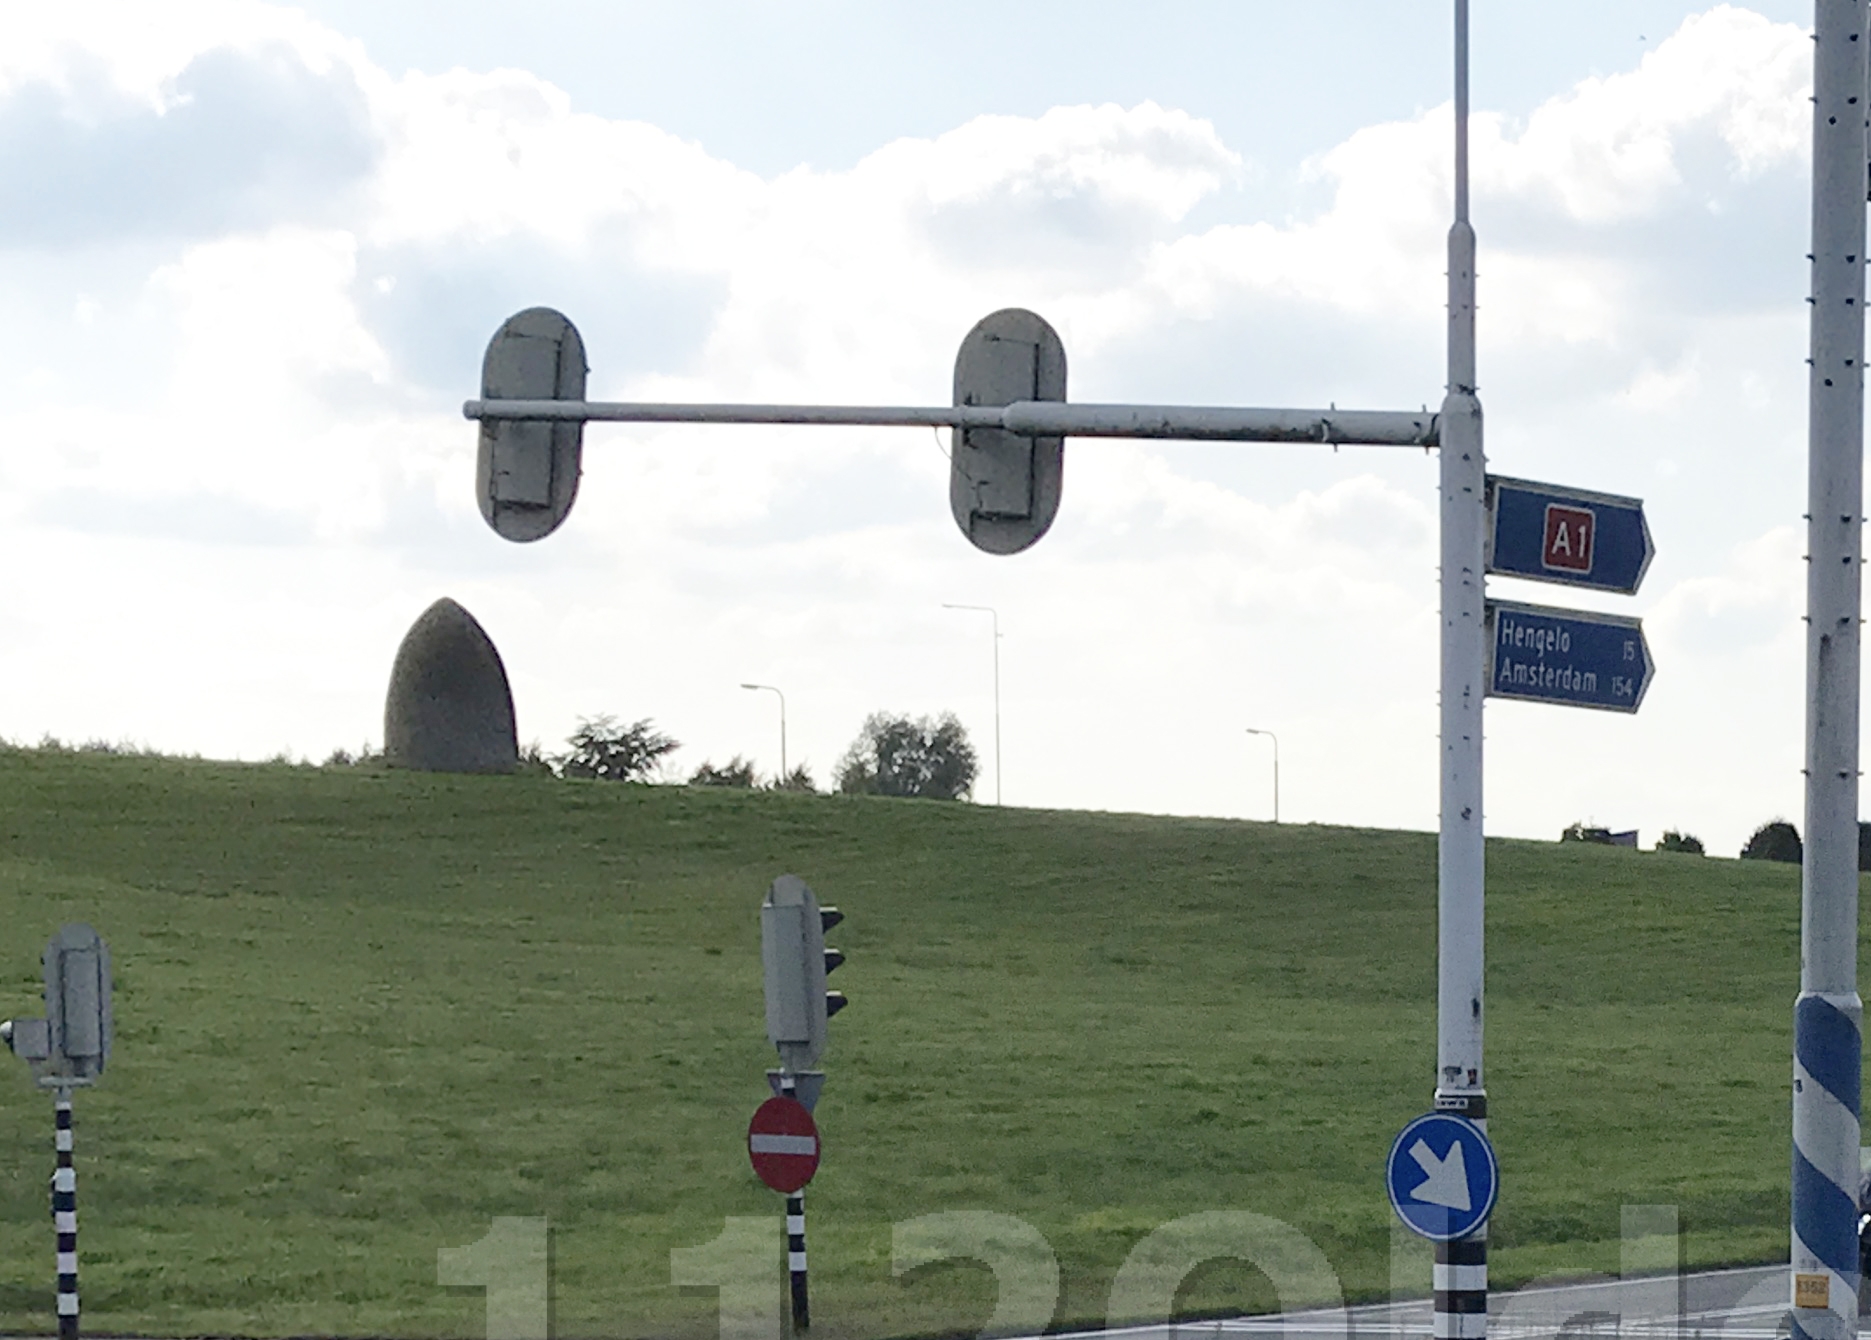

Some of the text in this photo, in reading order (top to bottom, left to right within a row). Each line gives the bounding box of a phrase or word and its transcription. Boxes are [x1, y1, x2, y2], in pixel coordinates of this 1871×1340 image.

[1552, 520, 1586, 558] A1
[1502, 619, 1635, 661] Hengelo 15
[1499, 656, 1634, 697] Amsterdam 154
